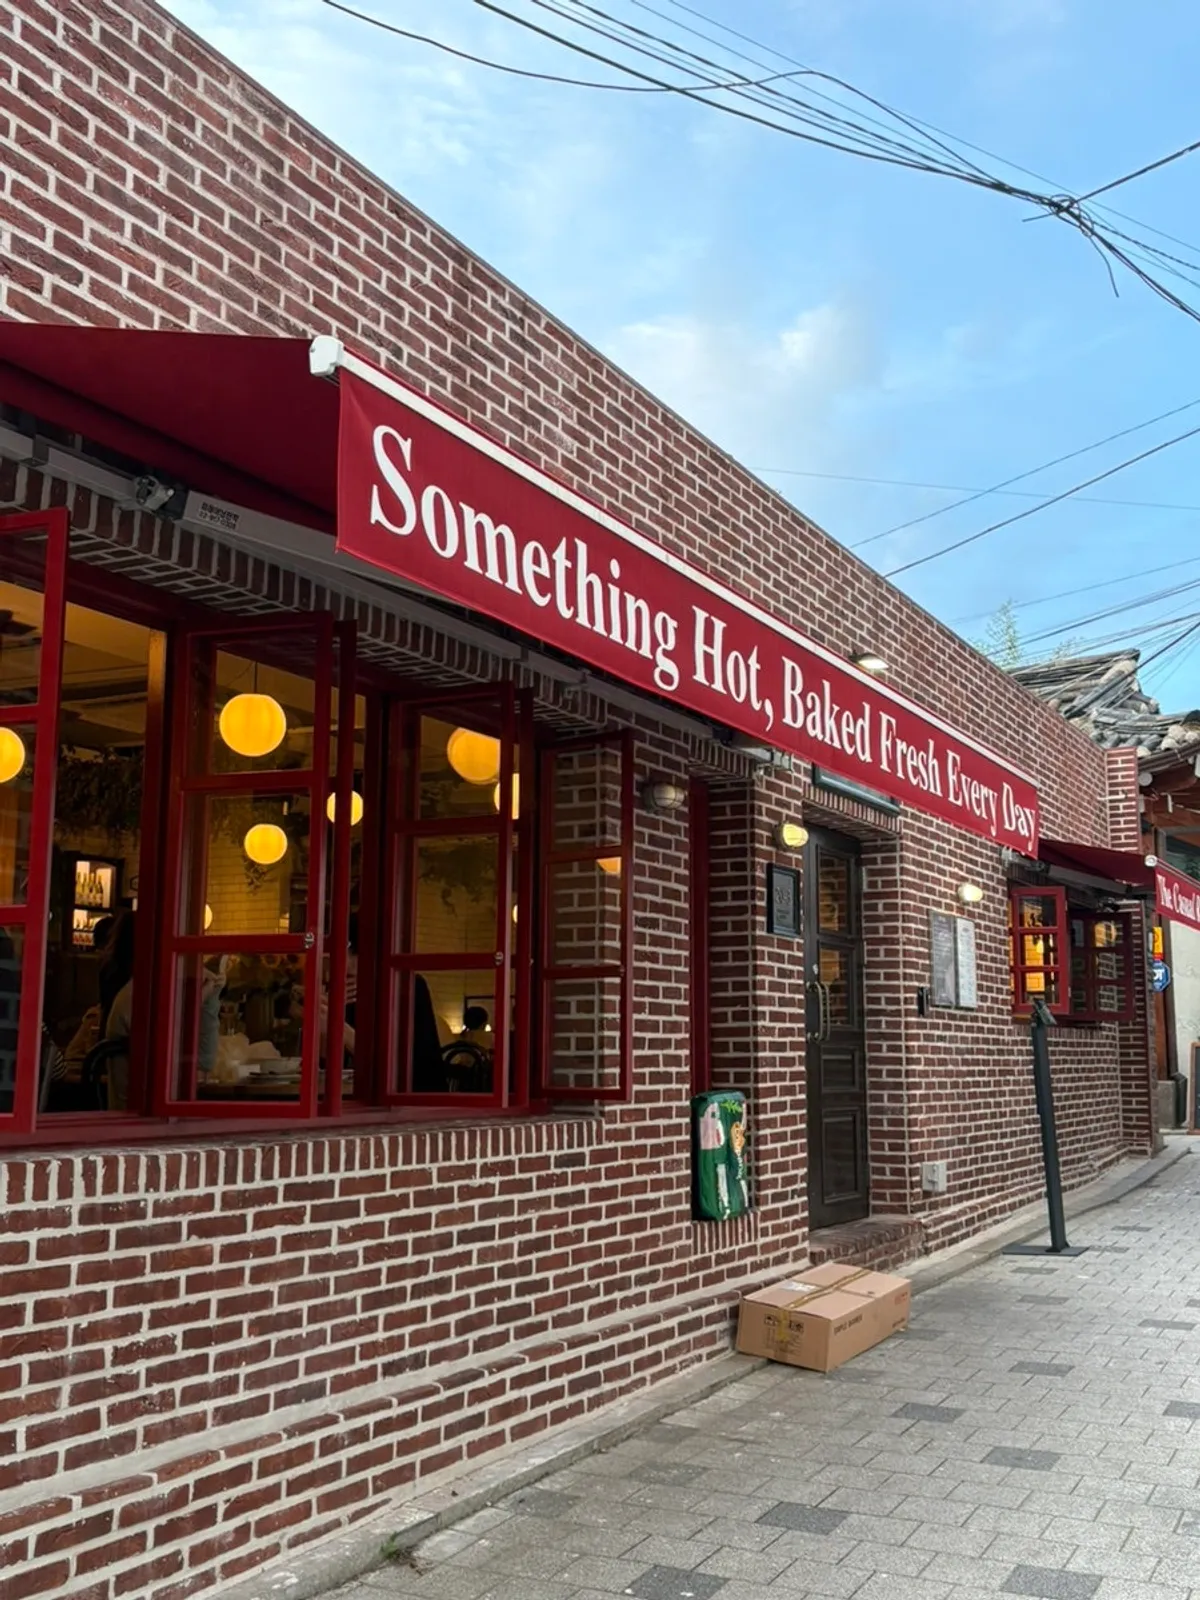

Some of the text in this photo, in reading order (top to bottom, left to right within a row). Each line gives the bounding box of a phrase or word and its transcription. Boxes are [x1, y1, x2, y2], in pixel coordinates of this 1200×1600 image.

[370, 424, 1037, 852] Something Hot, Baked Fresh Every Day
